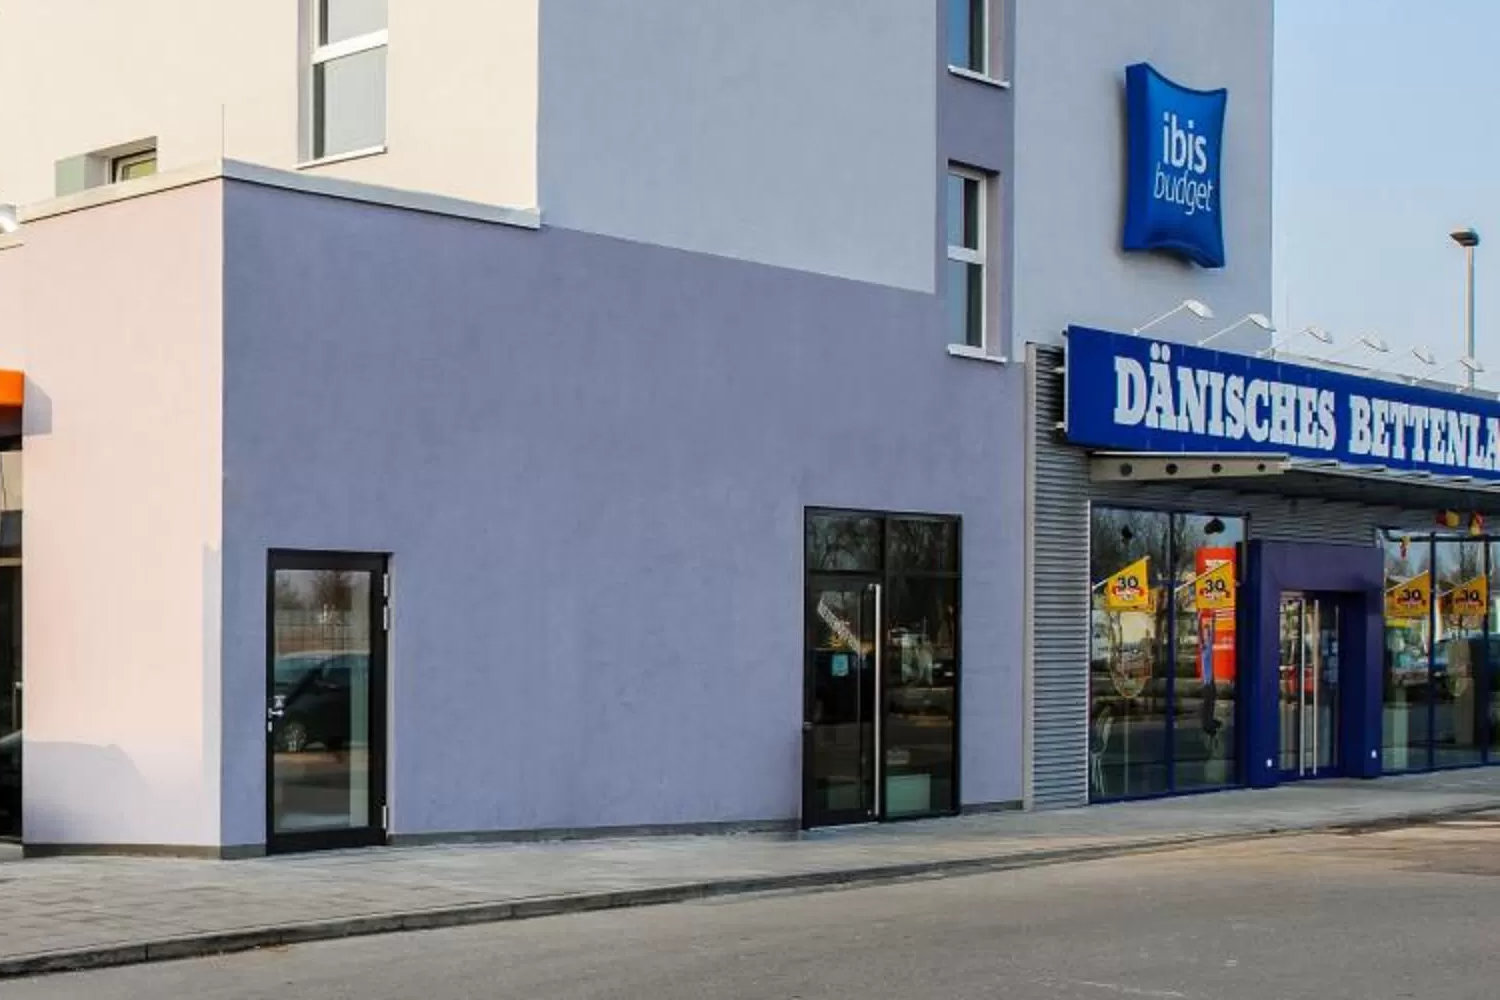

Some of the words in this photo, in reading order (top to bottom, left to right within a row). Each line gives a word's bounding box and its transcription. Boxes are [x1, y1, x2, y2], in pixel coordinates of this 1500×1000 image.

[1163, 111, 1208, 174] ibis
[1153, 161, 1214, 216] budget
[1113, 342, 1337, 452] DÄNISCHES
[1348, 394, 1500, 473] BETTENLA
[1117, 575, 1139, 589] 30
[1204, 578, 1226, 593] 30
